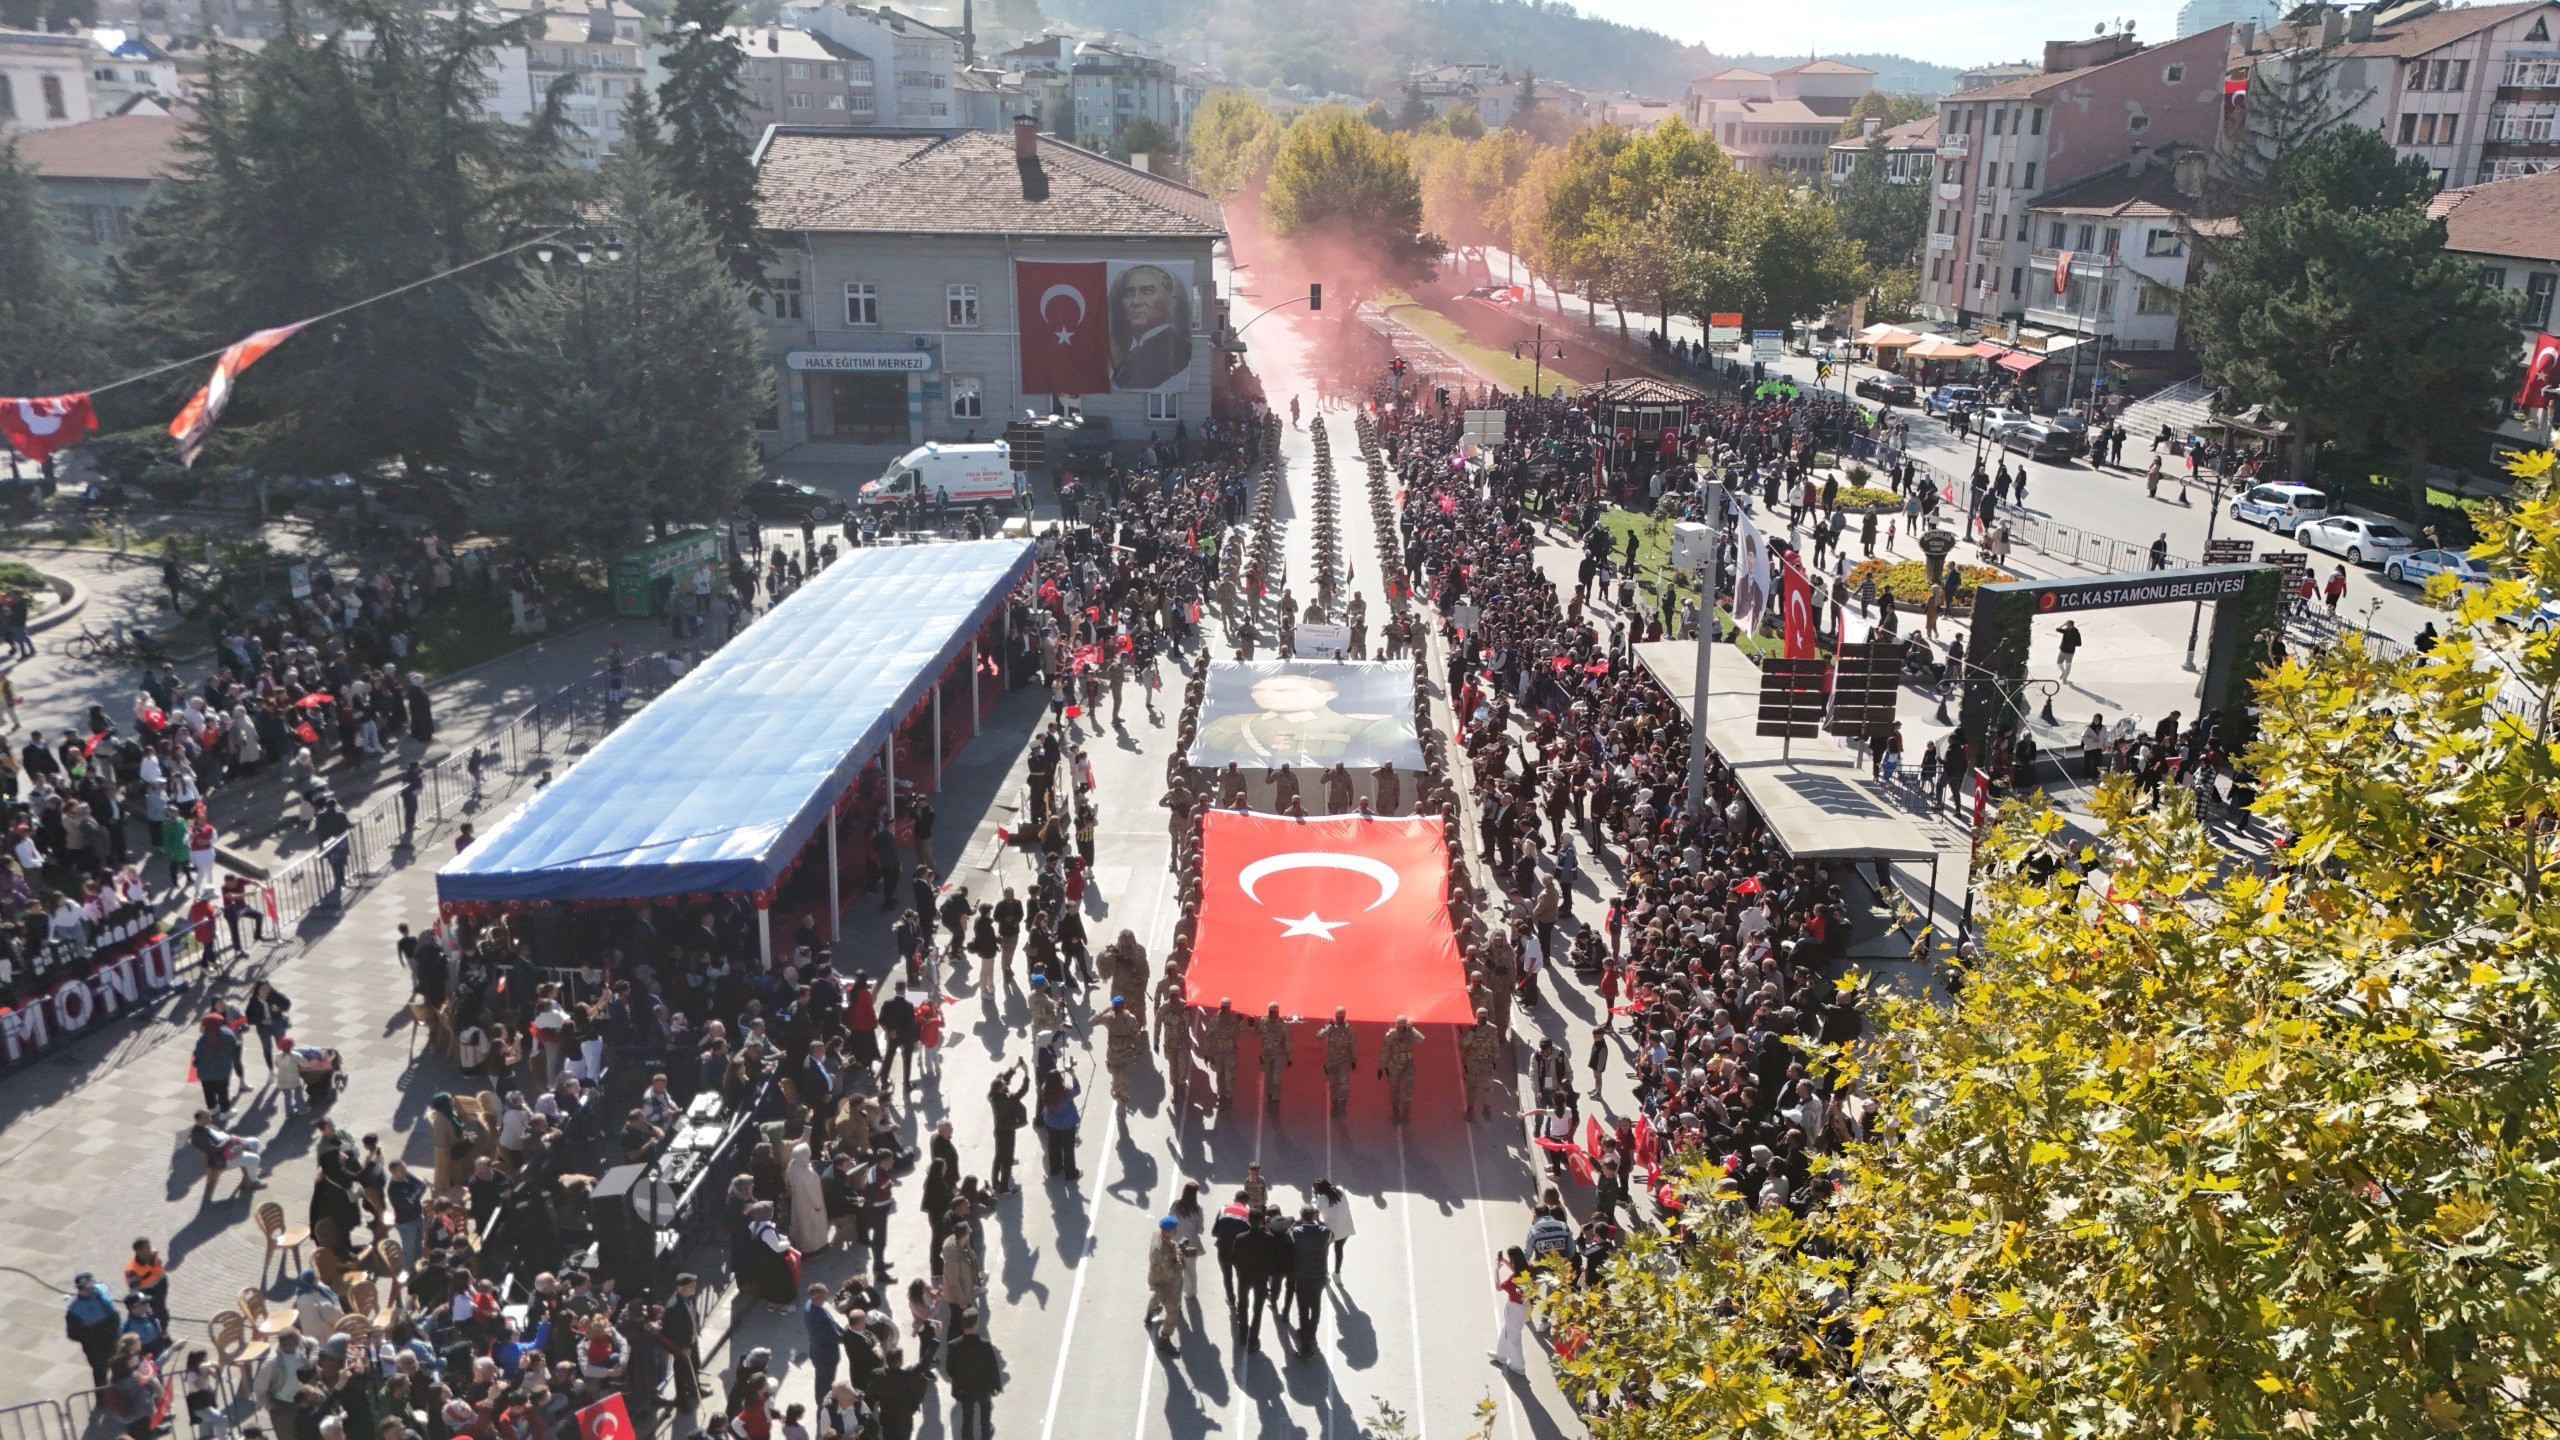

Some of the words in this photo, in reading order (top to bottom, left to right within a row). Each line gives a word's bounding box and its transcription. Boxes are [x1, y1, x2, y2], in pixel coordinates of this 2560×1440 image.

[804, 357, 833, 368] HALK
[836, 355, 875, 369] EĞİTİMİ
[877, 356, 923, 369] MERKEZİ
[2059, 594, 2080, 607] T.C.
[2082, 584, 2169, 605] KASTAMONU
[2169, 575, 2246, 598] BELEDİYESİ
[1, 937, 174, 1060] MONU
